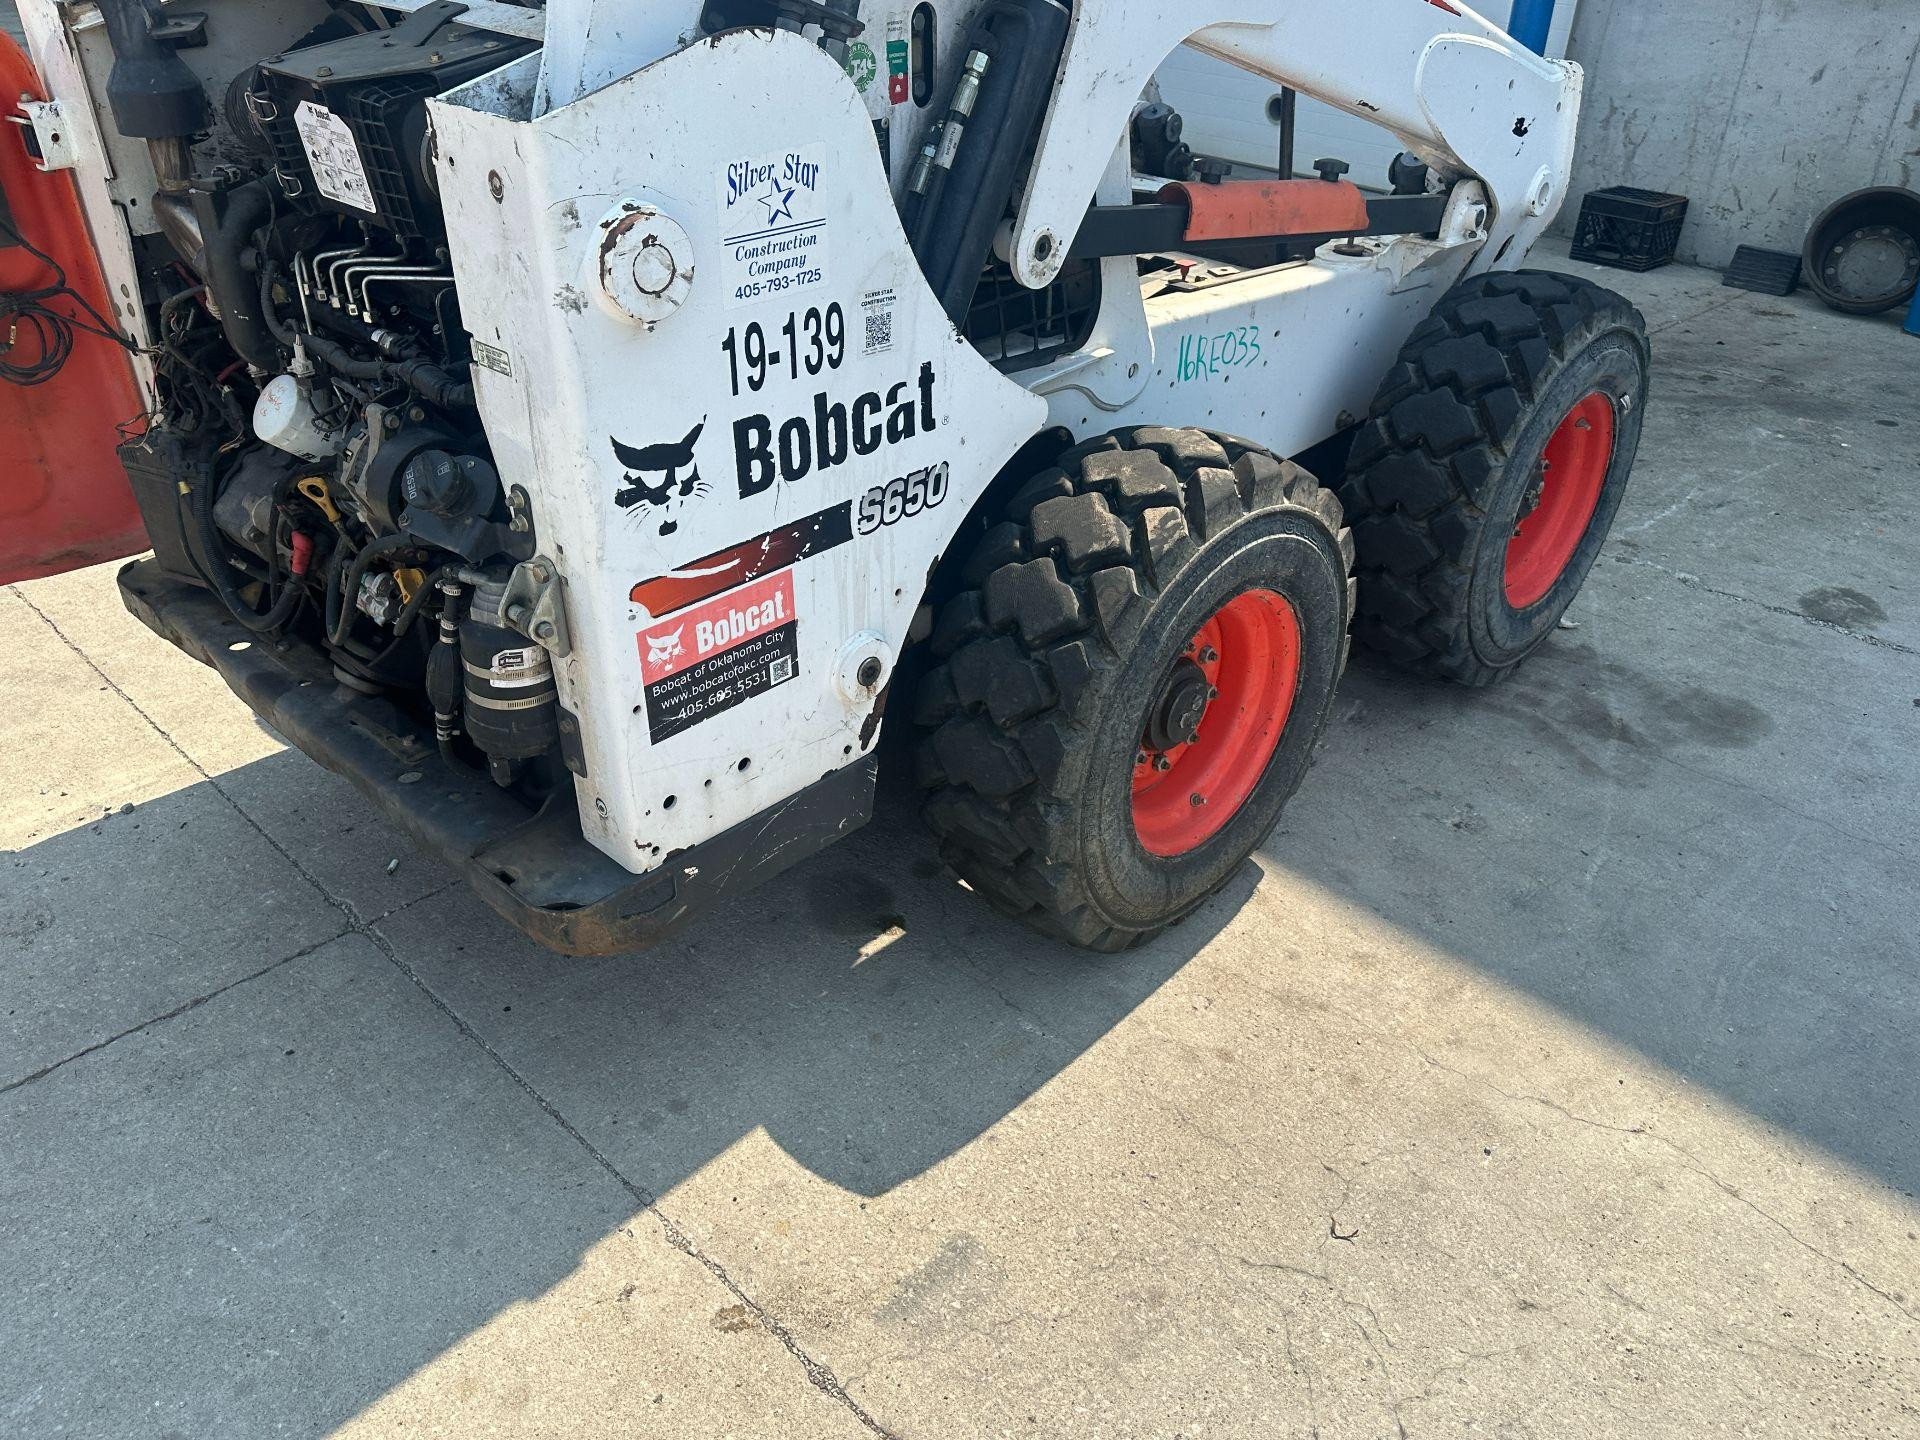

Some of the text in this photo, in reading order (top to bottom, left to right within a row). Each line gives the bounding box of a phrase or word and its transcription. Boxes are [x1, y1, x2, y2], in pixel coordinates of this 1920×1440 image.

[727, 153, 819, 209] Silver Star
[735, 233, 817, 262] Construction
[748, 254, 807, 277] Company
[735, 268, 822, 300] 405-793-1725
[861, 295, 897, 307] CONSTRUCTION
[865, 288, 893, 299] SILVER STAR
[722, 301, 845, 397] 19-139
[1177, 325, 1260, 383] 16RE033
[732, 360, 936, 500] Bobcat
[406, 466, 418, 500] DIESEL
[857, 460, 950, 536] S650
[695, 590, 785, 656] Bobcat
[652, 630, 785, 698] Bobcat of Oklahoma City
[660, 648, 781, 710] www.bobcatofokc.com
